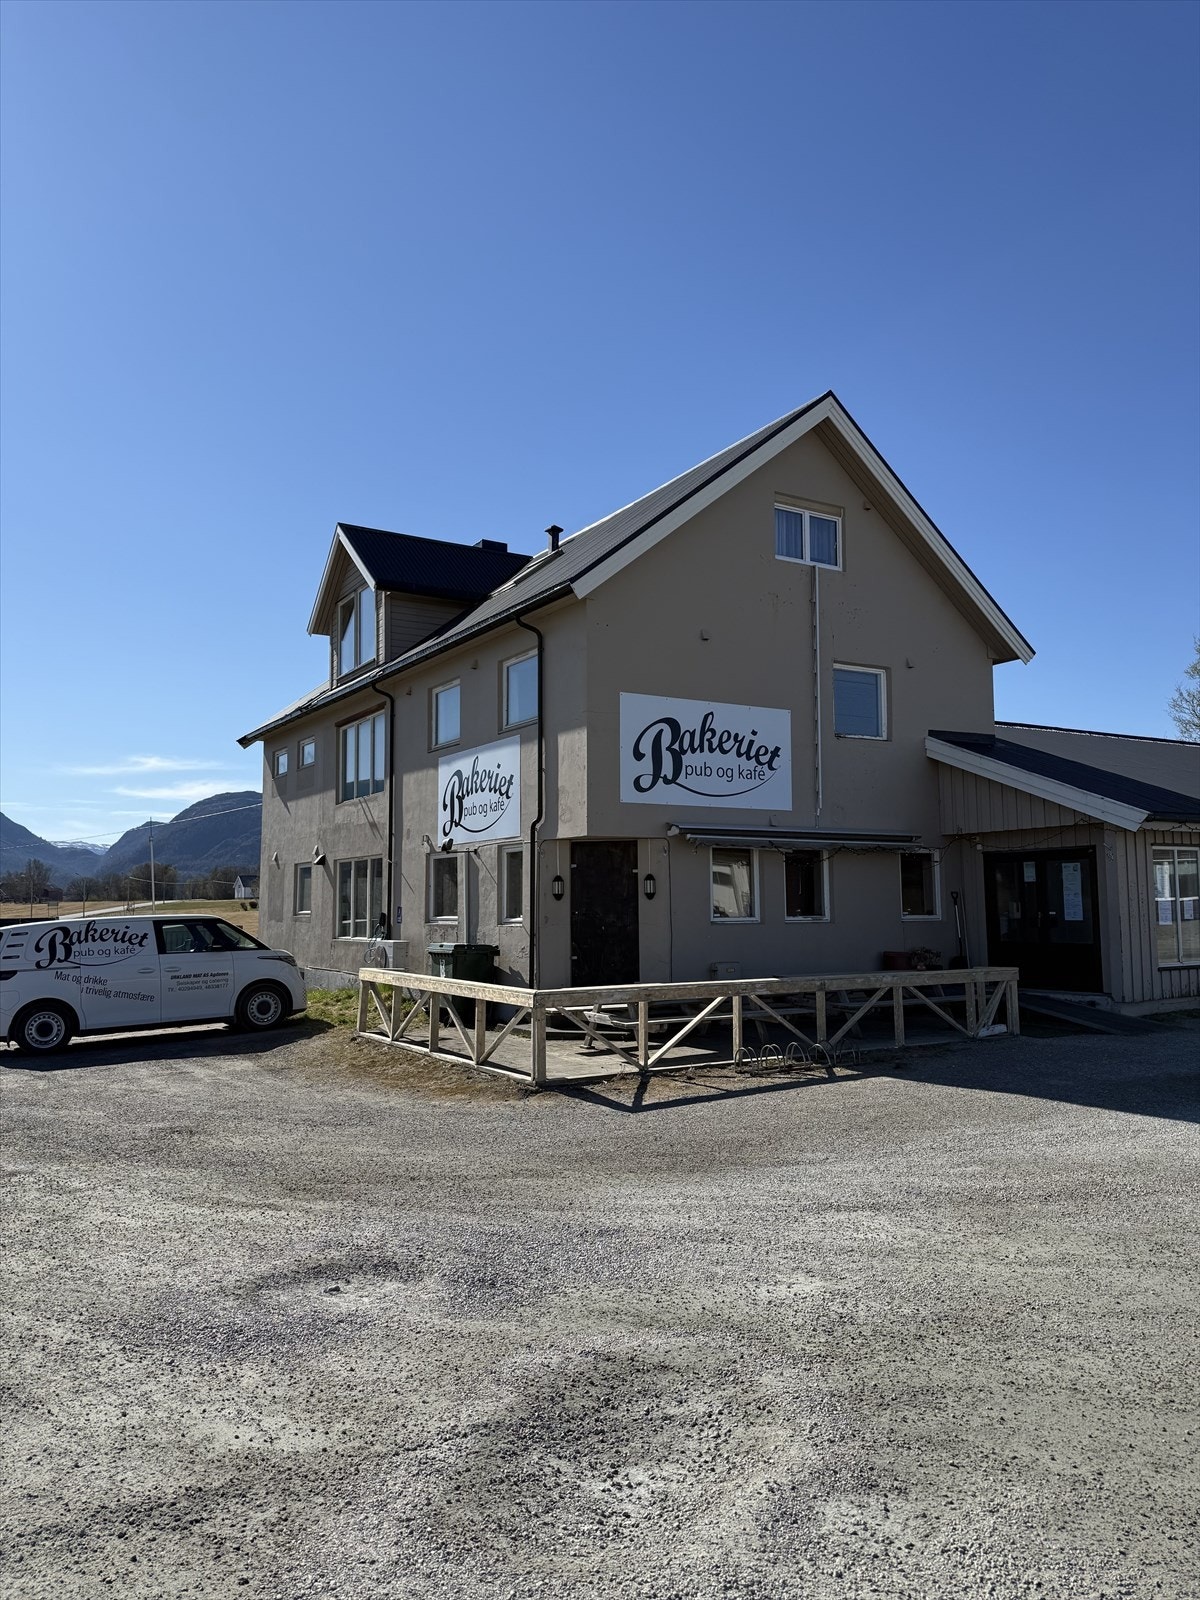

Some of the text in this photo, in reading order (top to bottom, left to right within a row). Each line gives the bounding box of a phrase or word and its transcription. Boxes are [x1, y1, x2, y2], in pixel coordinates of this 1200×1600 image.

[632, 711, 782, 793] Bakeriet
[684, 762, 766, 782] pub og kafé
[442, 755, 515, 837] Bakeriet
[463, 797, 505, 820] pub og kafé
[34, 920, 149, 969] Bakeriet
[73, 945, 136, 959] pub og kafé
[54, 971, 108, 986] Mat og drikke
[85, 986, 112, 999] trivelig
[112, 990, 155, 1002] atmosfære
